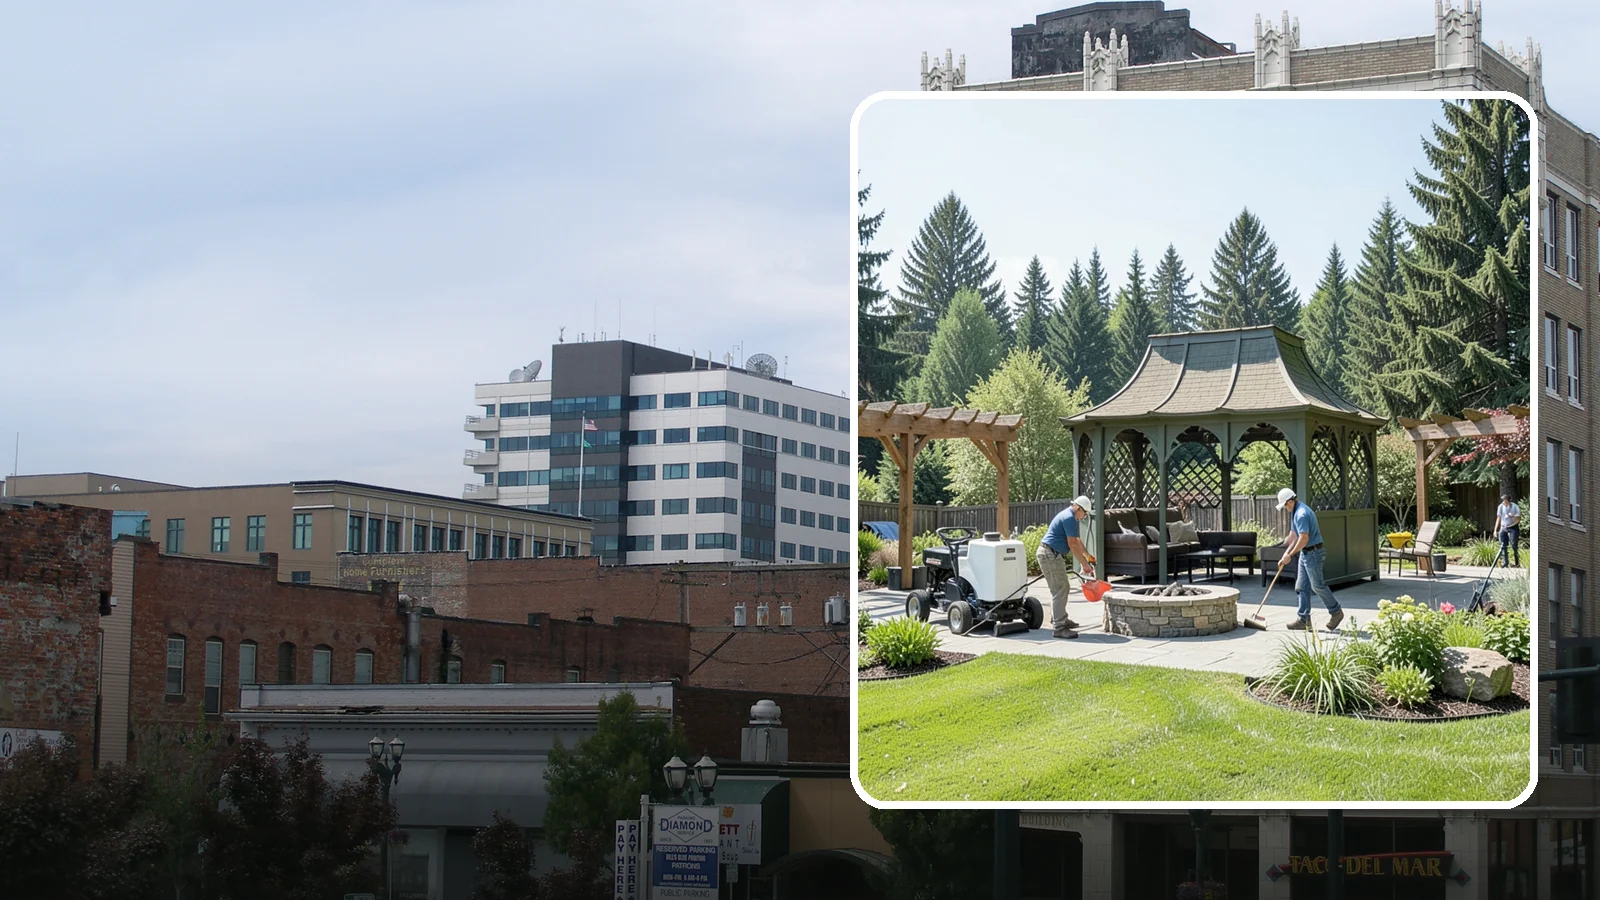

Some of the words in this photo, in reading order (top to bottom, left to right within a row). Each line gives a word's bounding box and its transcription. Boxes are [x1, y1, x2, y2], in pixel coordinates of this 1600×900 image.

[660, 818, 713, 833] DIAMOND
[1021, 815, 1069, 828] BUILDING
[617, 825, 625, 852] PAY
[628, 824, 637, 852] PAY
[656, 845, 688, 854] RESERVED
[689, 846, 716, 855] PARKING
[721, 851, 739, 861] Soup
[672, 862, 701, 870] PATRONS
[1346, 857, 1384, 875] DEL
[1392, 857, 1442, 876] MAR
[616, 856, 625, 894] HERE
[627, 855, 636, 894] HERE
[661, 888, 682, 897] PUBLIC
[683, 889, 711, 898] PARKING
